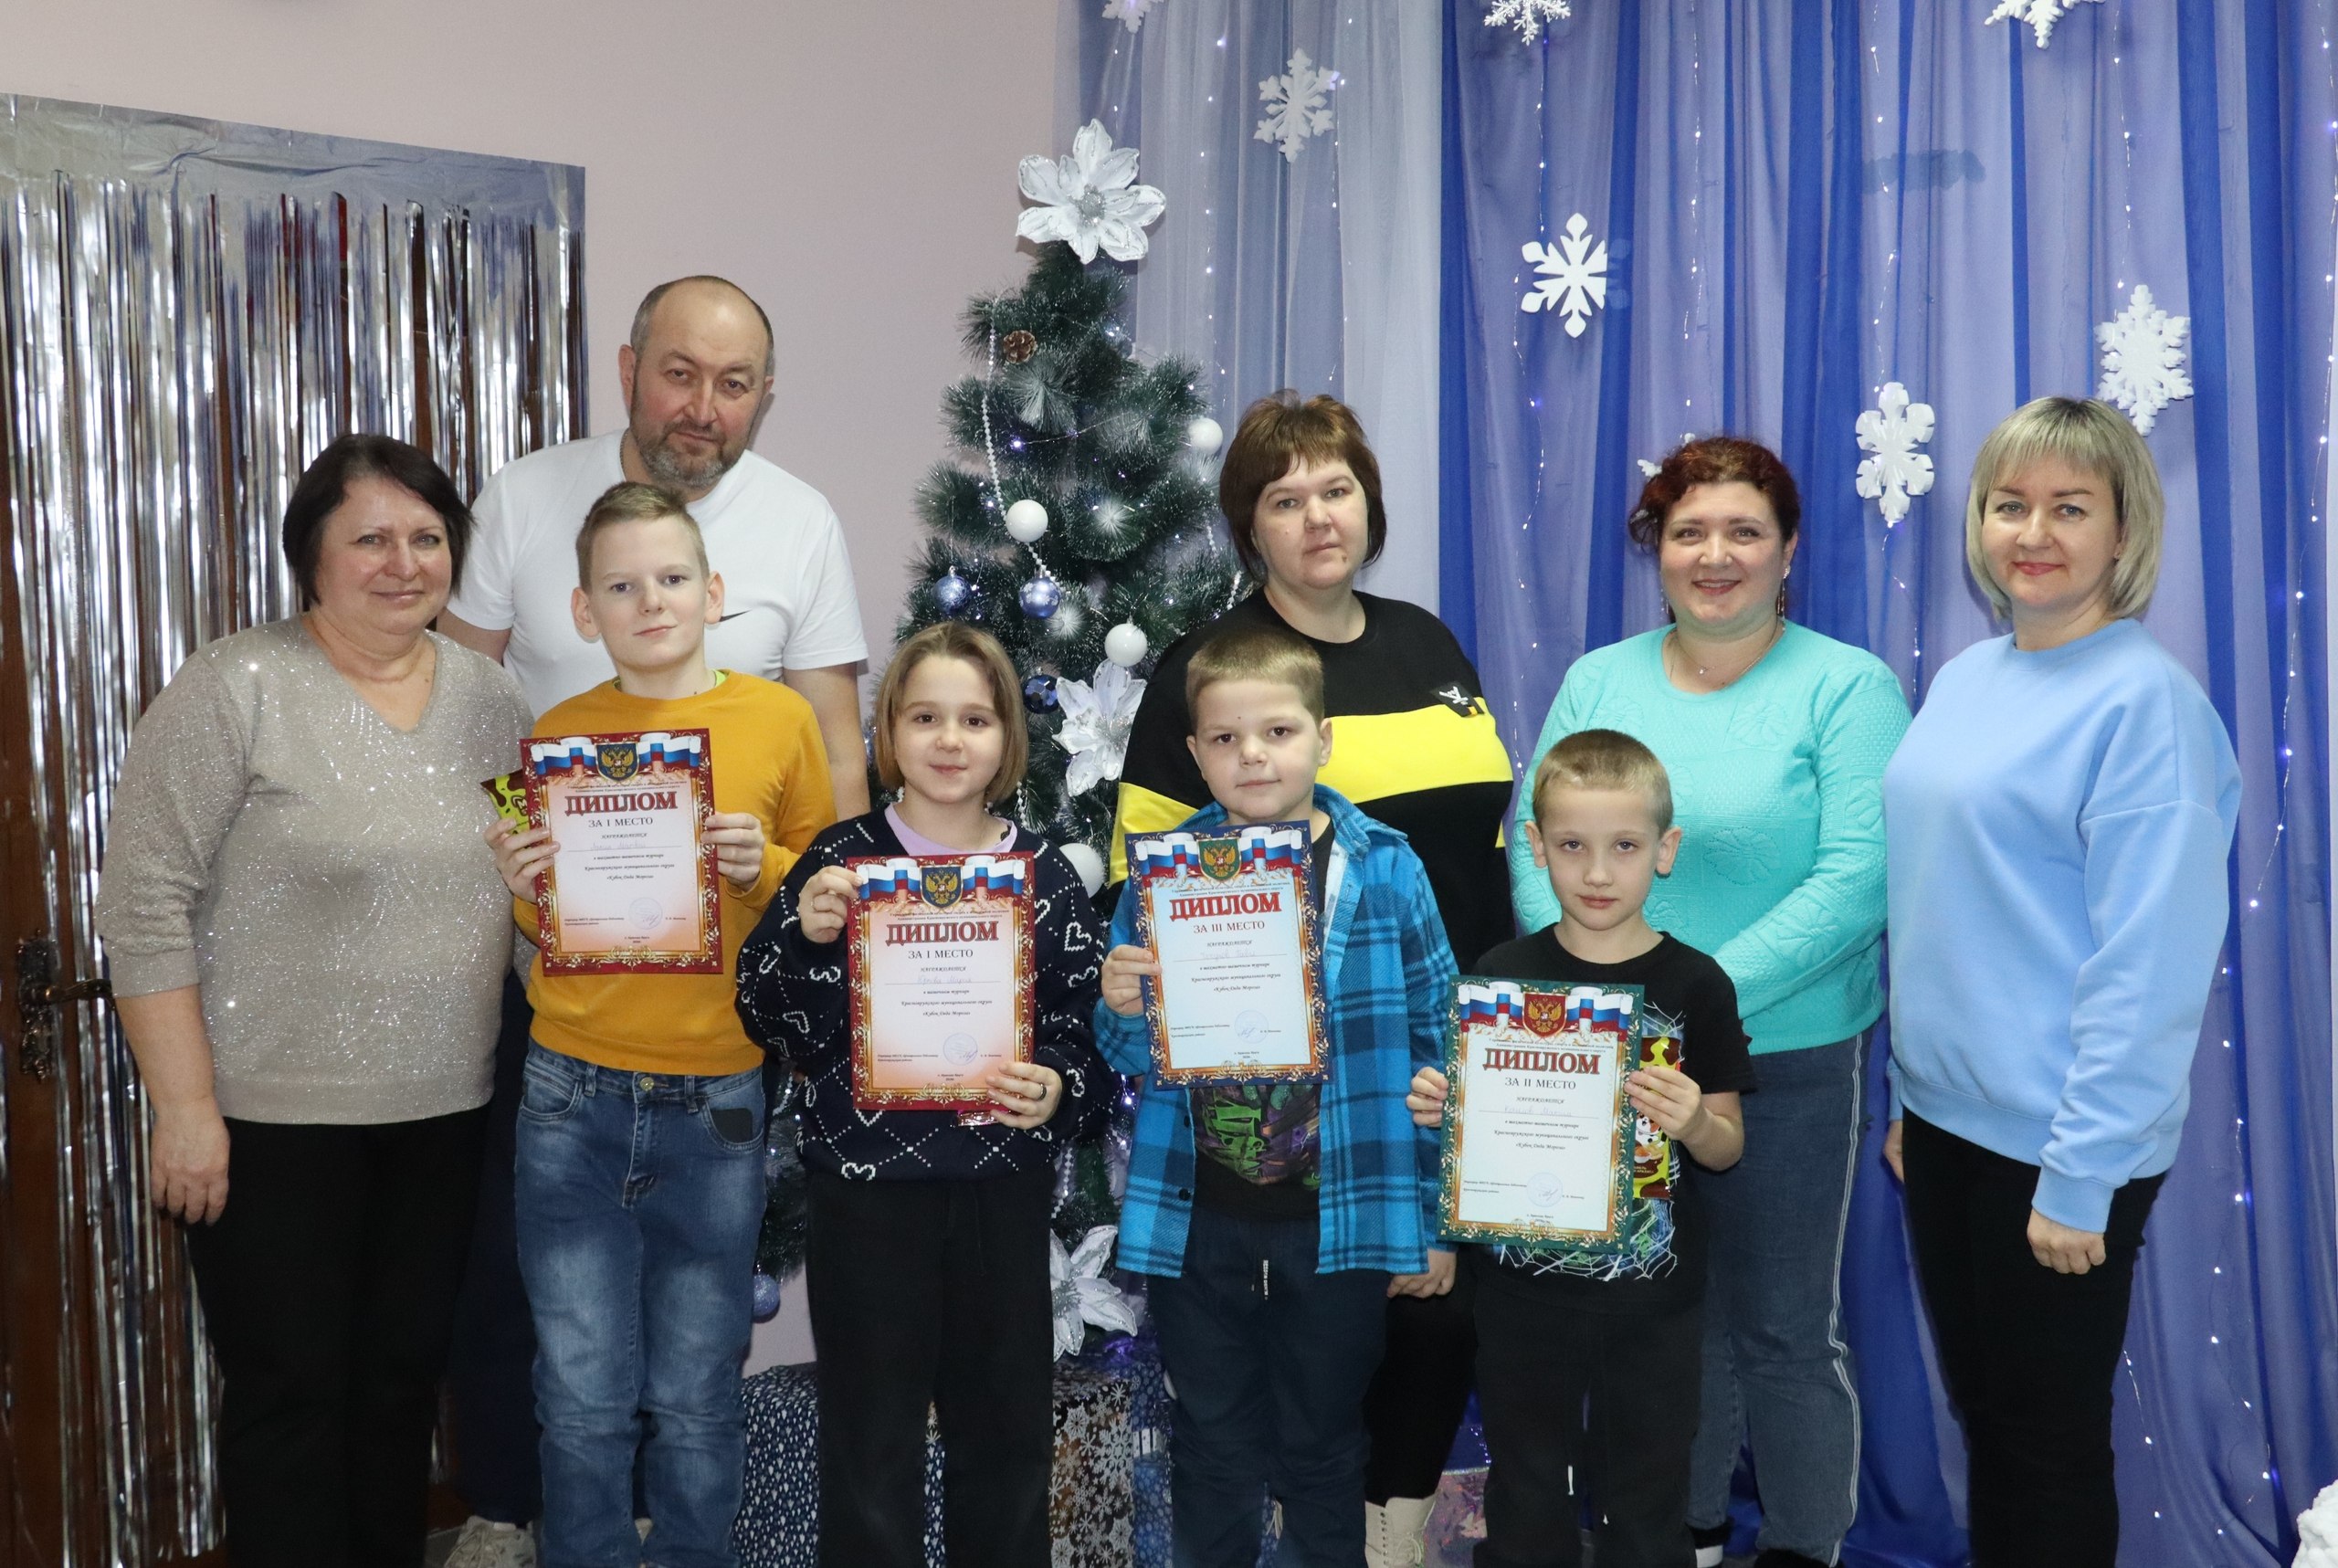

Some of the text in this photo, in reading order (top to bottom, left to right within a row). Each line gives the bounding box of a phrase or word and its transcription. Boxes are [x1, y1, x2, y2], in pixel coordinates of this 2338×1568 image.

[564, 791, 678, 816] ДИПЛОМ
[588, 819, 603, 828] ЗА
[615, 816, 653, 826] МЕСТО
[1169, 891, 1282, 922] ДИПЛОМ
[885, 921, 999, 946] ДИПЛОМ
[1193, 921, 1265, 934] ЗА III МЕСТО
[908, 949, 974, 959] ЗА I МЕСТО
[1482, 1047, 1601, 1075] ДИПЛОМ
[1504, 1077, 1576, 1089] ЗА II МЕСТО
